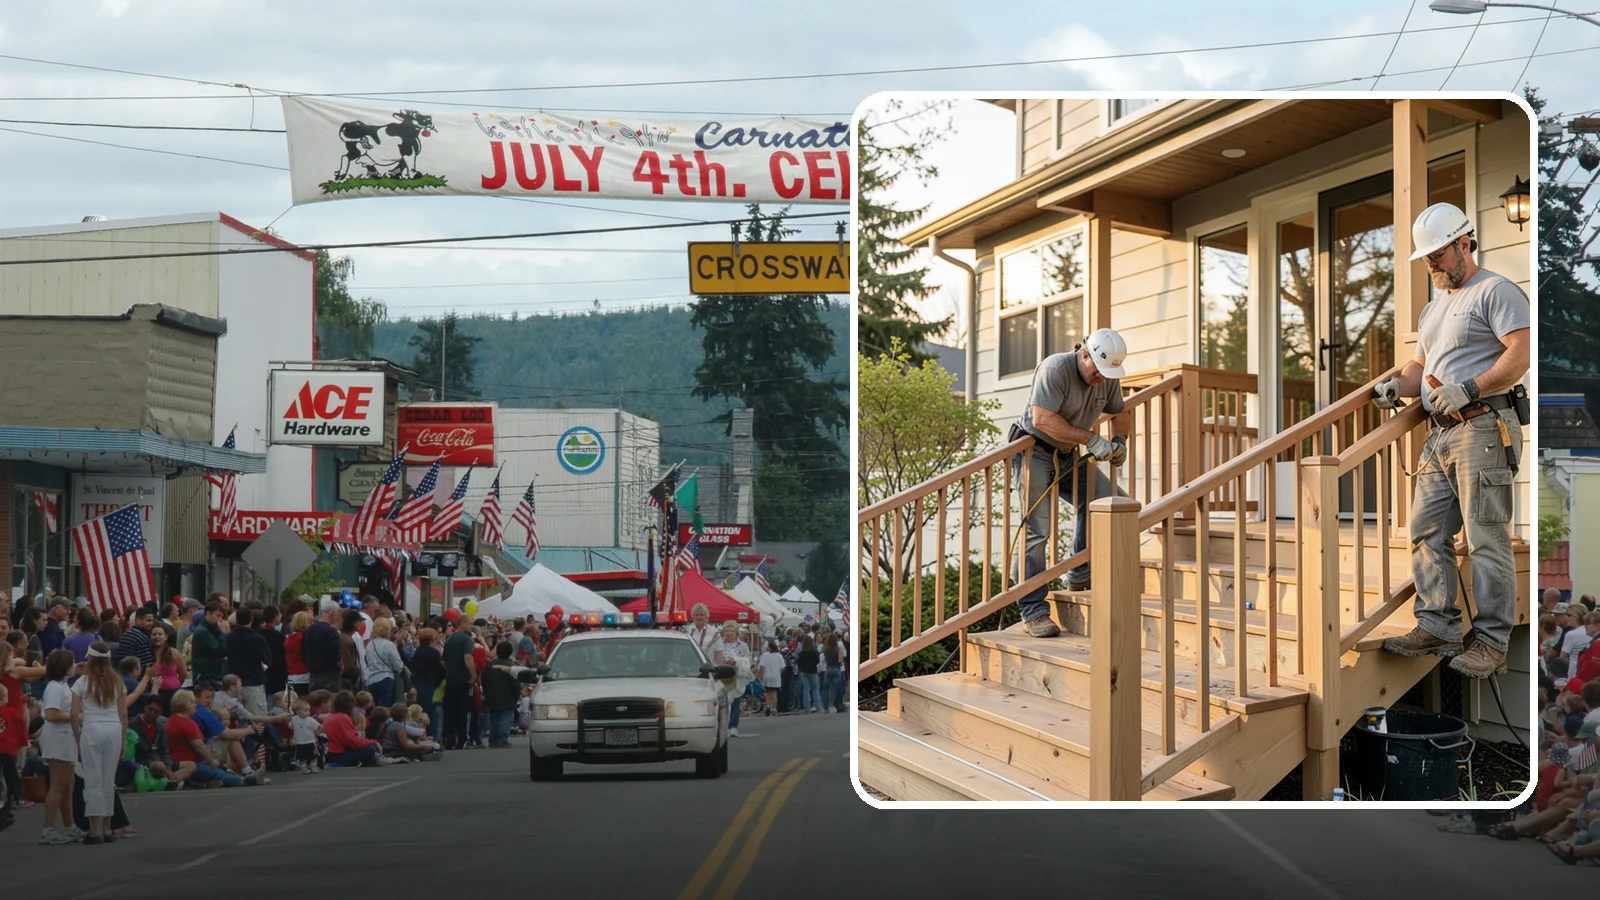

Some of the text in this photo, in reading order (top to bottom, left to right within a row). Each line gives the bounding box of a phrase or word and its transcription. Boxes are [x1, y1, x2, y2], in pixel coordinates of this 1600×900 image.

[695, 121, 850, 150] Carnat
[481, 140, 605, 193] JULY
[632, 150, 746, 197] 4th.
[697, 254, 850, 280] CROSSWA
[282, 380, 373, 420] ACE
[405, 409, 452, 422] CEDAR
[283, 421, 370, 436] Hardware
[416, 428, 477, 447] Coca-Cola
[95, 485, 124, 495] Vincent
[126, 486, 136, 495] de
[137, 486, 155, 495] Paul
[212, 516, 331, 536] HARDARE
[688, 526, 741, 535] CRNATION
[699, 535, 730, 543] GLASS
